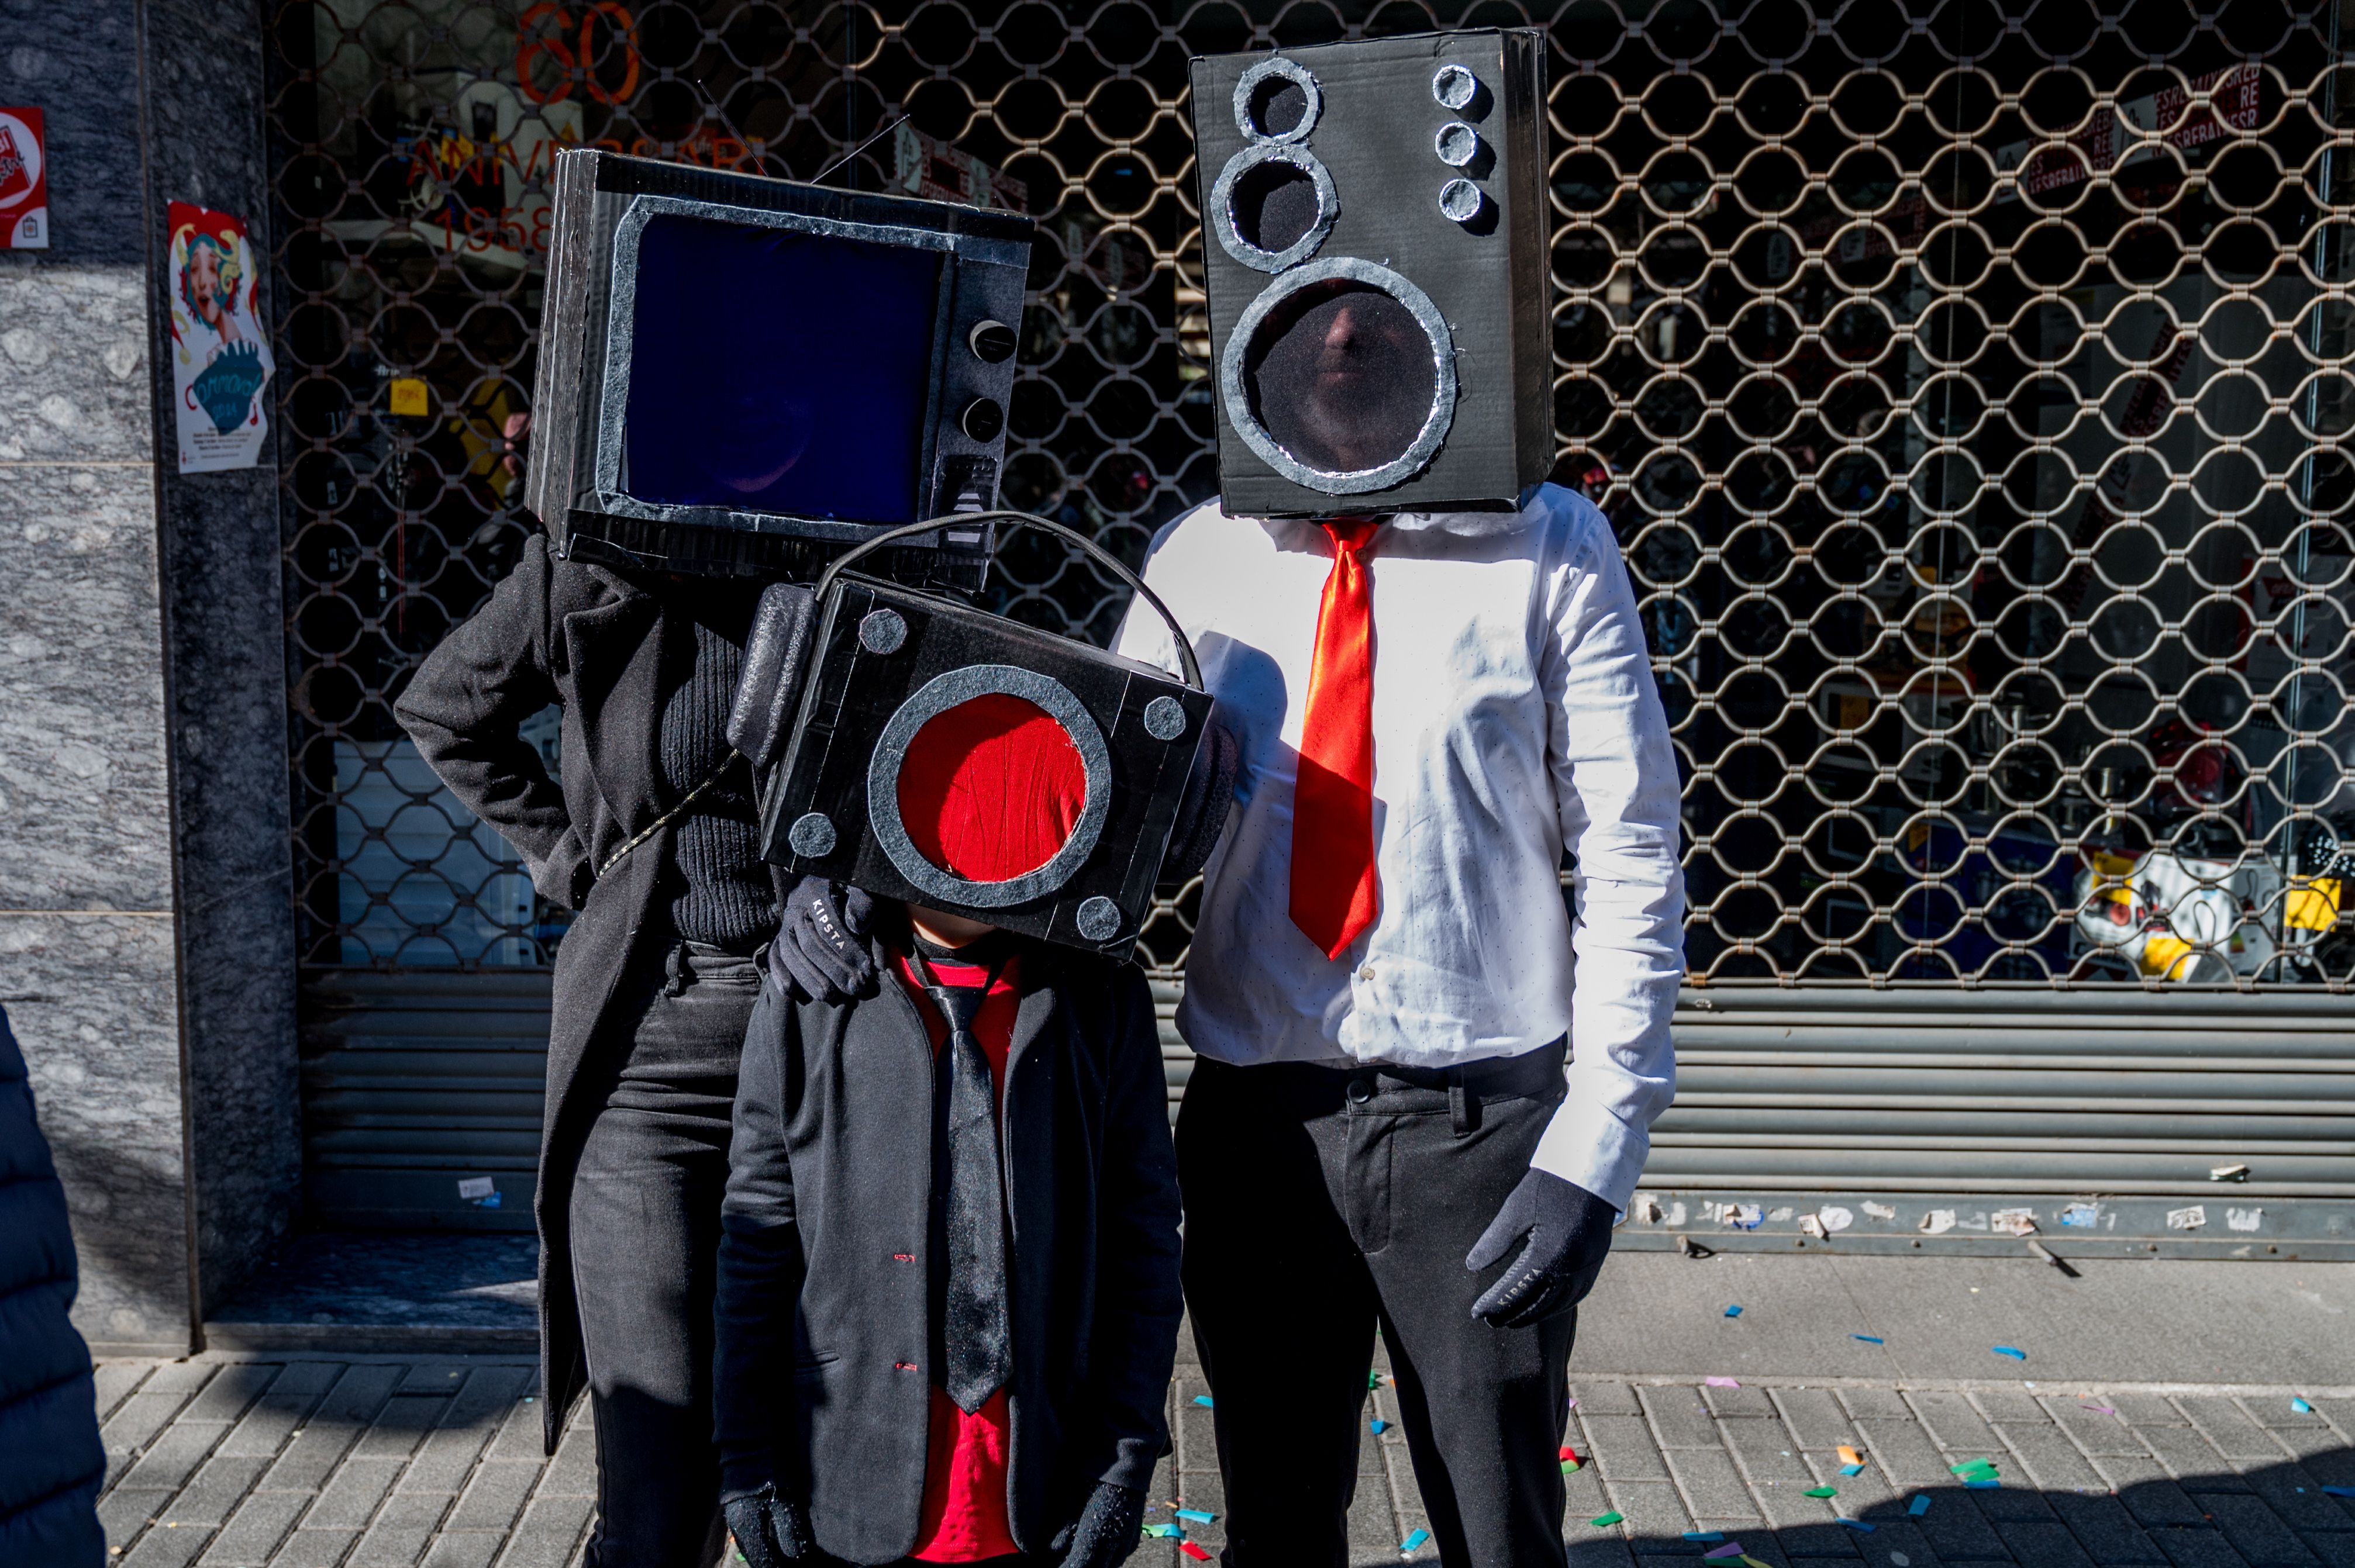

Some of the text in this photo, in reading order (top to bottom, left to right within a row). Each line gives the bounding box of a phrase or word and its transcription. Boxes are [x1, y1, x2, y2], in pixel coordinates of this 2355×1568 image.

[516, 2, 639, 105] 60
[434, 206, 551, 253] 1958
[185, 367, 264, 410] Carnaval
[812, 899, 845, 949] KIPSTA
[1497, 1268, 1543, 1306] KIPSTA
